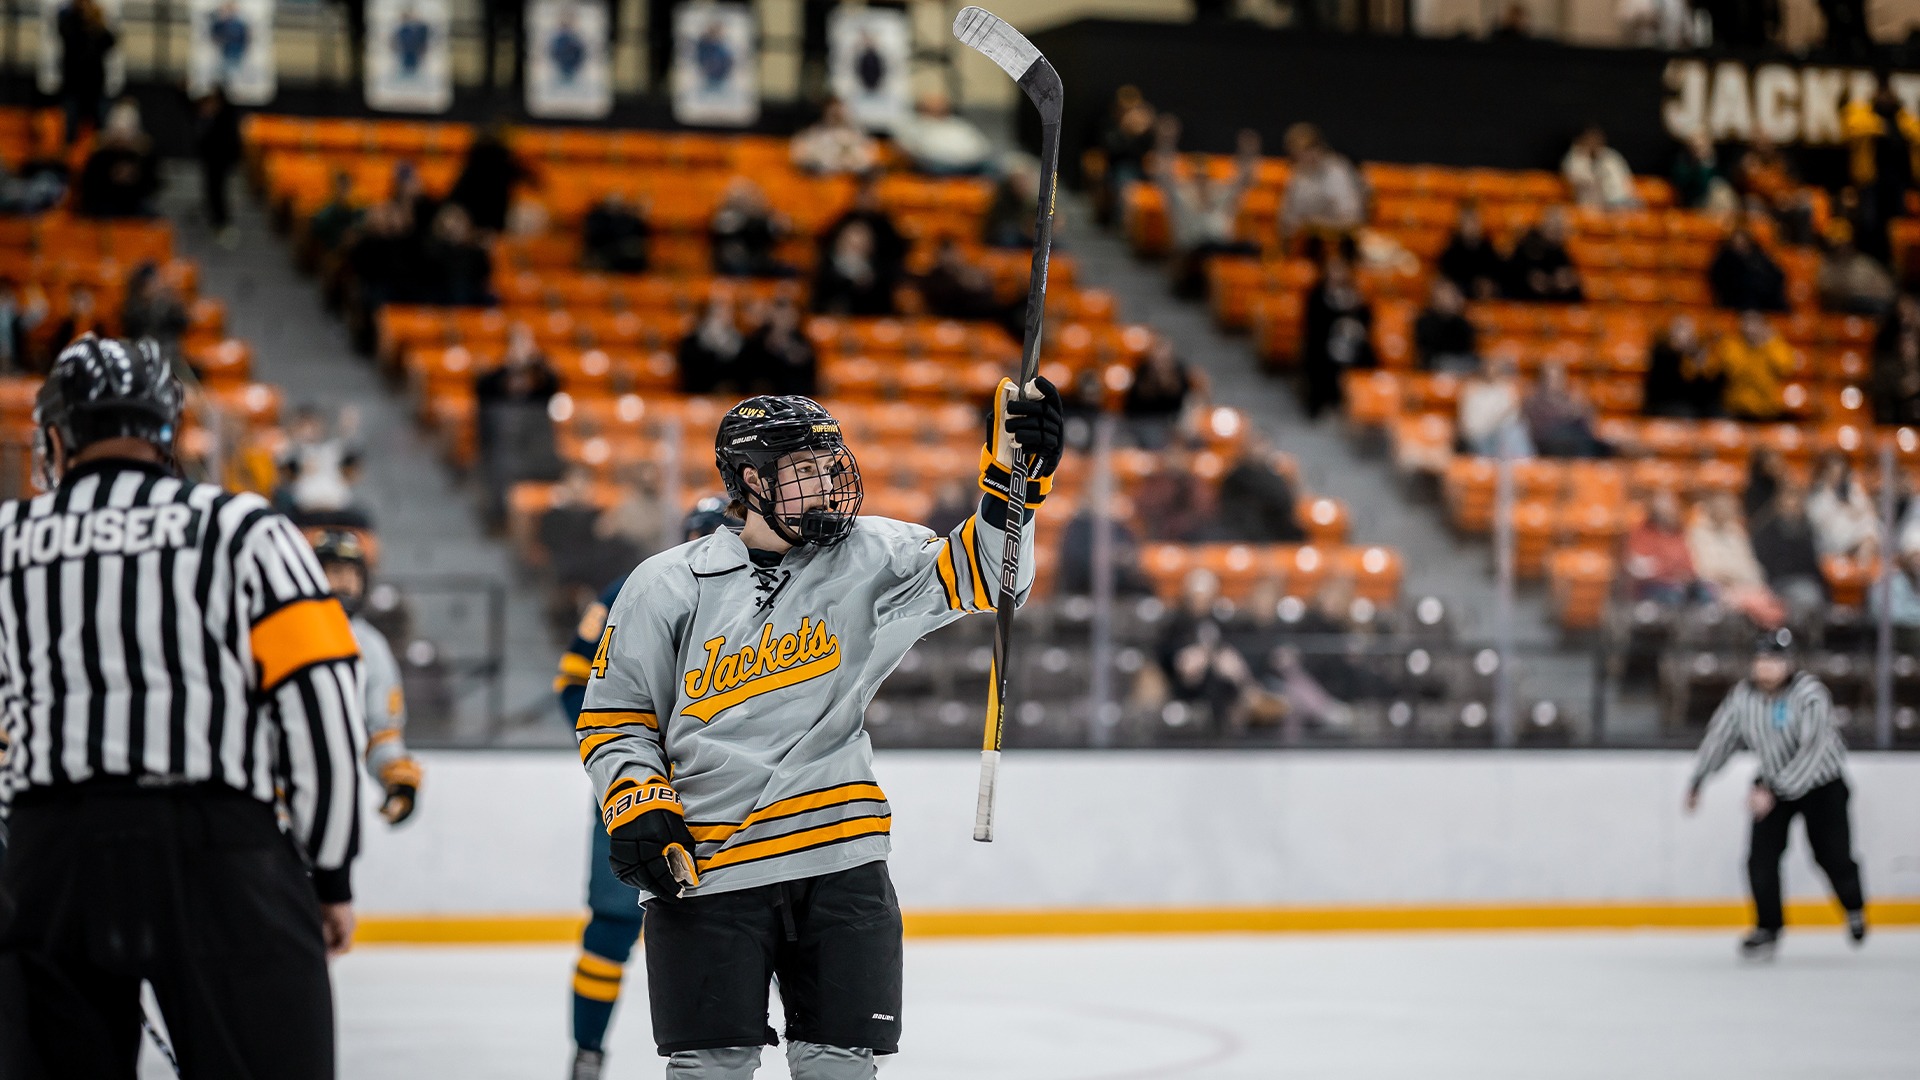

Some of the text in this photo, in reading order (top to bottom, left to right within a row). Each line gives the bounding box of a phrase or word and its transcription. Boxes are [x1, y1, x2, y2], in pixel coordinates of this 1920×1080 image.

[738, 407, 766, 418] UWS
[731, 434, 758, 446] BAUER
[983, 477, 1010, 493] BAUER
[2, 503, 192, 573] HOUSER
[592, 625, 616, 679] 4
[684, 616, 838, 699] Jackets
[996, 704, 1005, 750] NEXUS
[871, 1013, 894, 1022] BAUER
